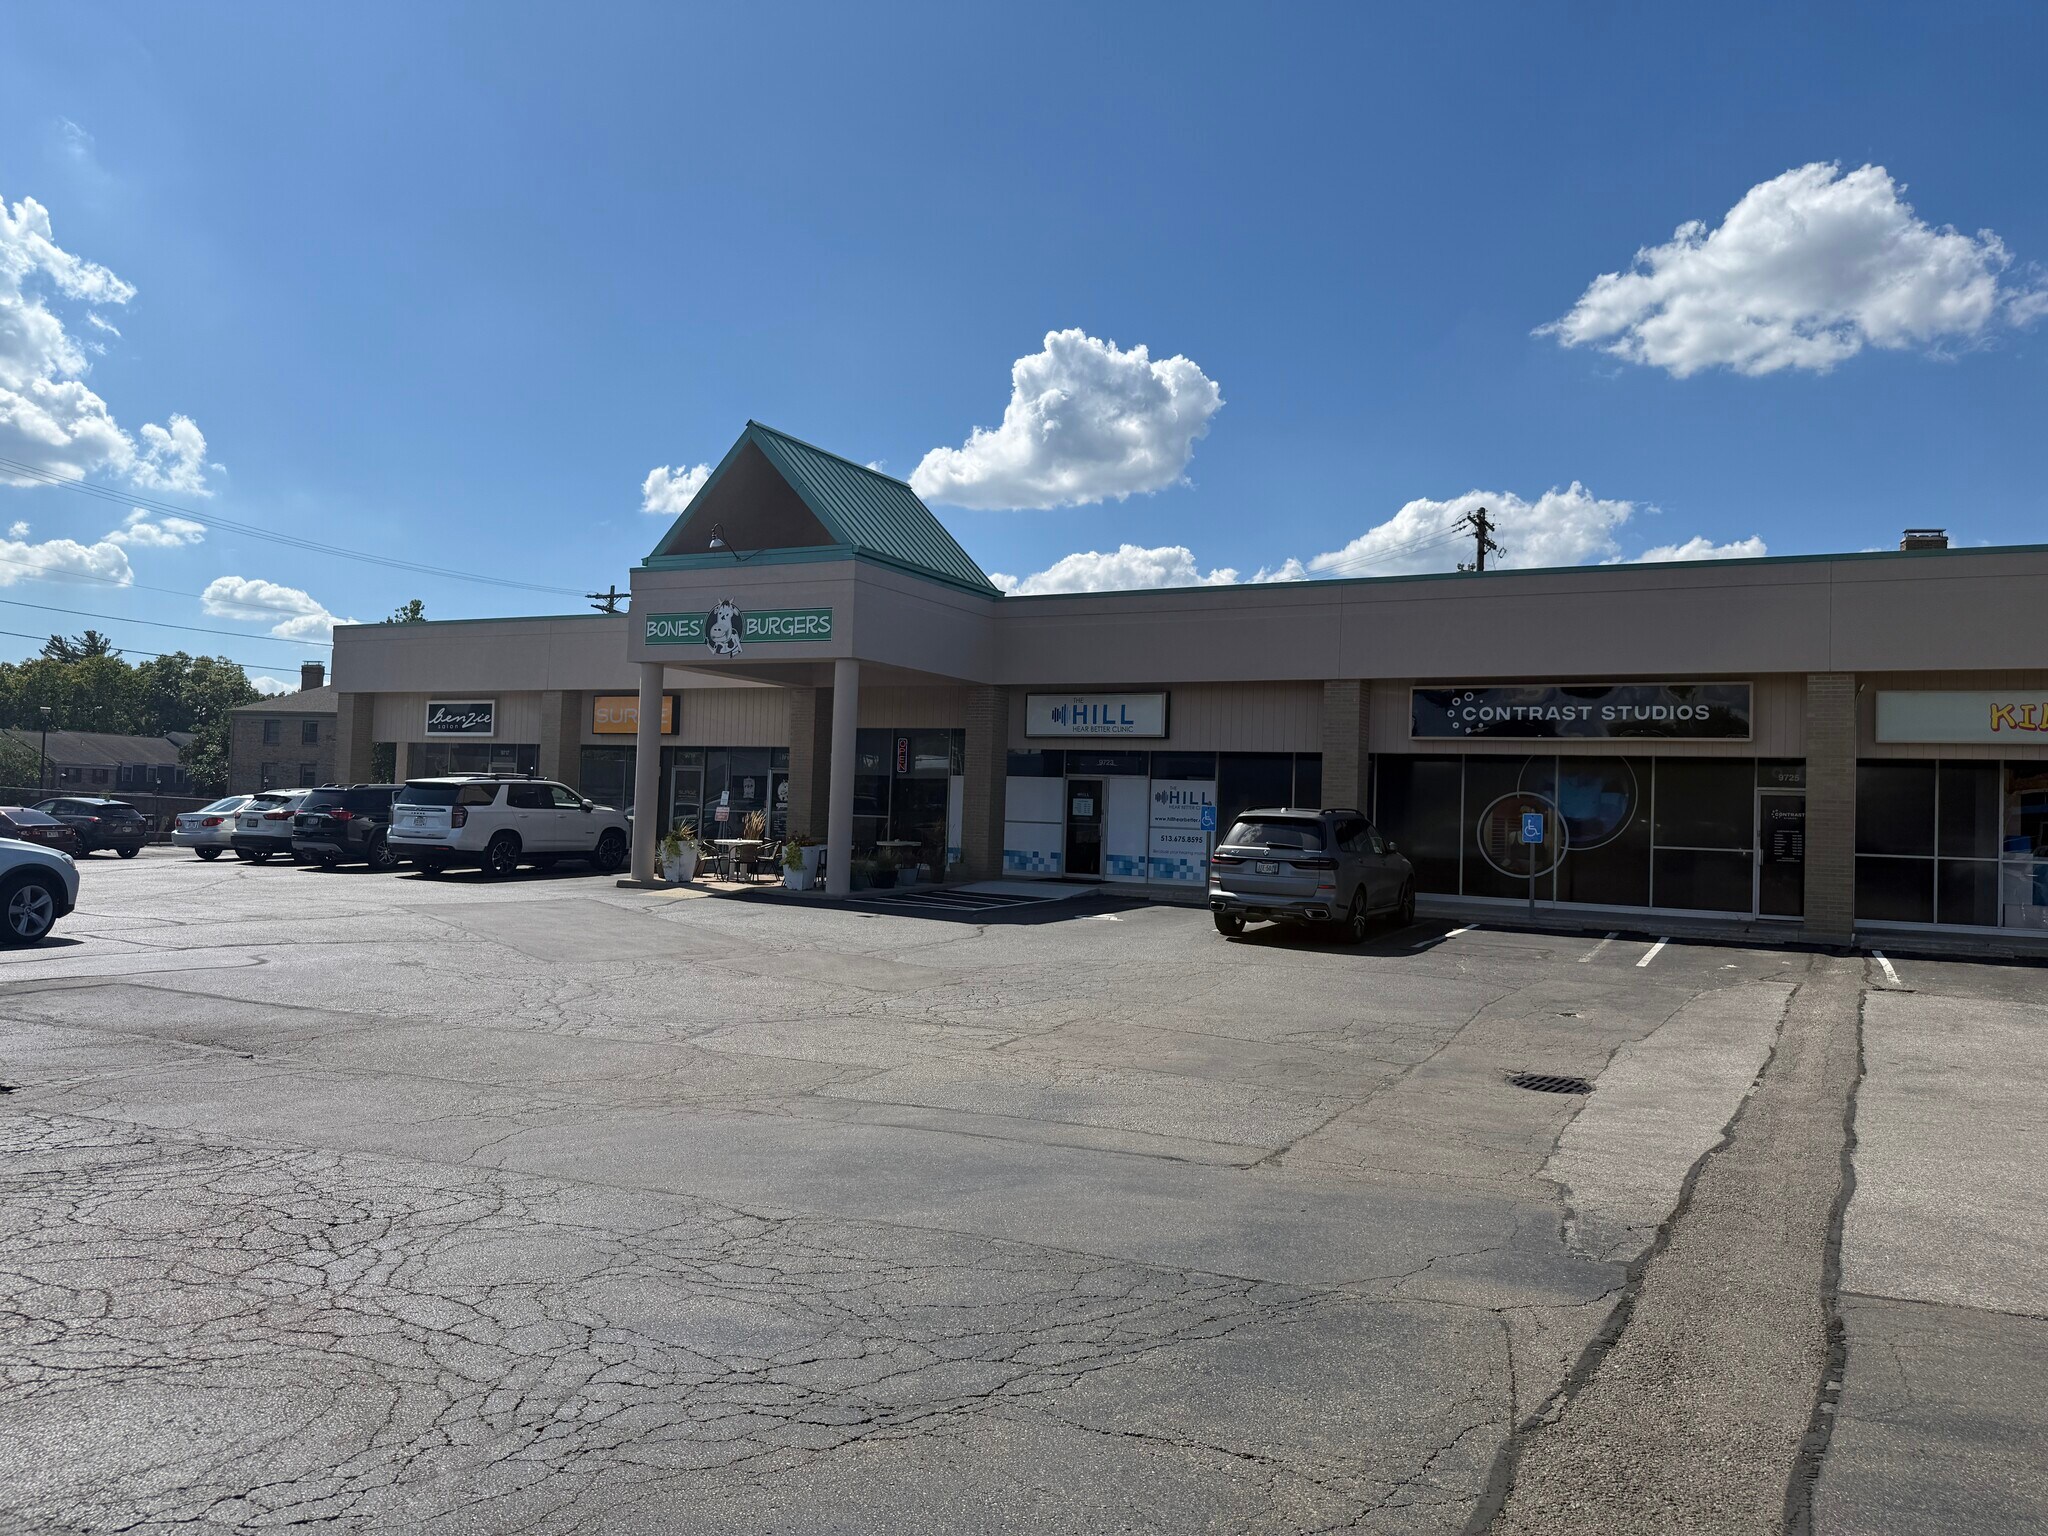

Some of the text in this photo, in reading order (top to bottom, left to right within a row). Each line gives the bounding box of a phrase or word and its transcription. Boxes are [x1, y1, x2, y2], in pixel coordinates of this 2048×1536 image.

[646, 615, 831, 637] BONES' BURGERS
[596, 708, 668, 724] SURE
[1072, 704, 1134, 725] HILL
[1462, 704, 1710, 721] CONTRAST STUDIOS
[1072, 725, 1134, 733] HEAR BETTER CLINIC
[1778, 774, 1800, 782] 9725
[1169, 790, 1212, 806] HILL
[1160, 835, 1203, 844] 513.675.8595
